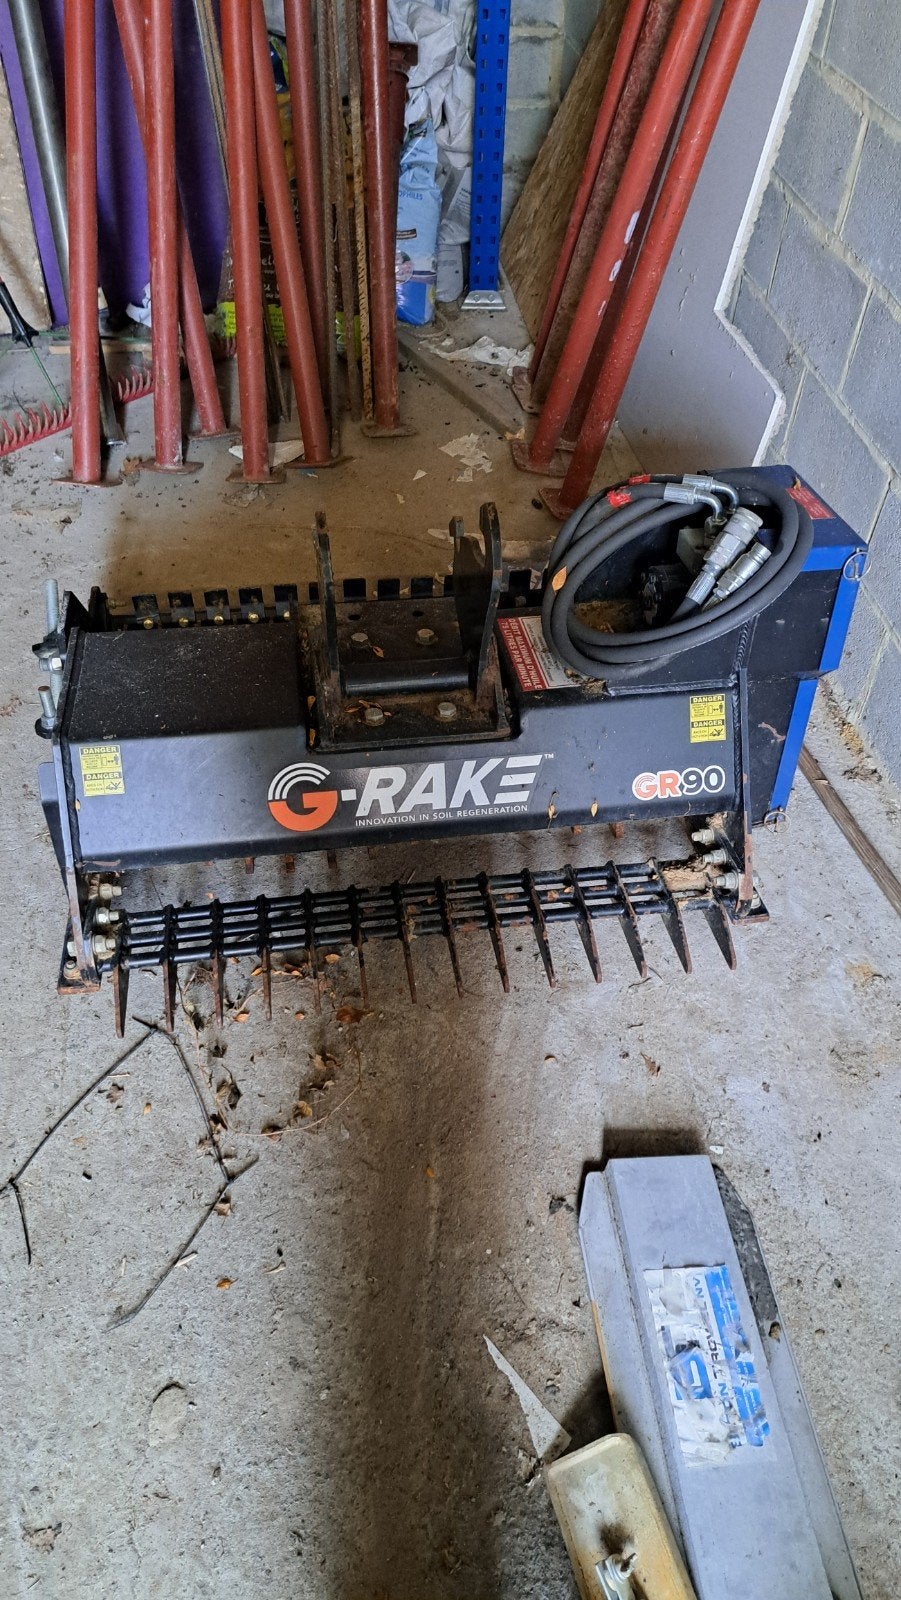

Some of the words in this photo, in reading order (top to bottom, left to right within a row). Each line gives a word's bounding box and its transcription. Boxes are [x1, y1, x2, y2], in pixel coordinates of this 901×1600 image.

[503, 629, 517, 649] LITRES
[511, 649, 523, 662] PAR
[514, 635, 533, 665] MAXIMUM
[526, 665, 542, 689] D'HUILE
[516, 663, 532, 687] MINUTE
[693, 695, 723, 703] DANGER
[693, 719, 723, 728] DANGER
[83, 746, 117, 754] DANGER
[86, 772, 120, 780] DANGER
[632, 765, 725, 801] GR90
[268, 755, 542, 832] G-RAKE
[355, 814, 416, 827] INNOVATION
[419, 813, 430, 821] IN
[433, 811, 453, 819] SOIL
[457, 804, 528, 818] REGENERATION
